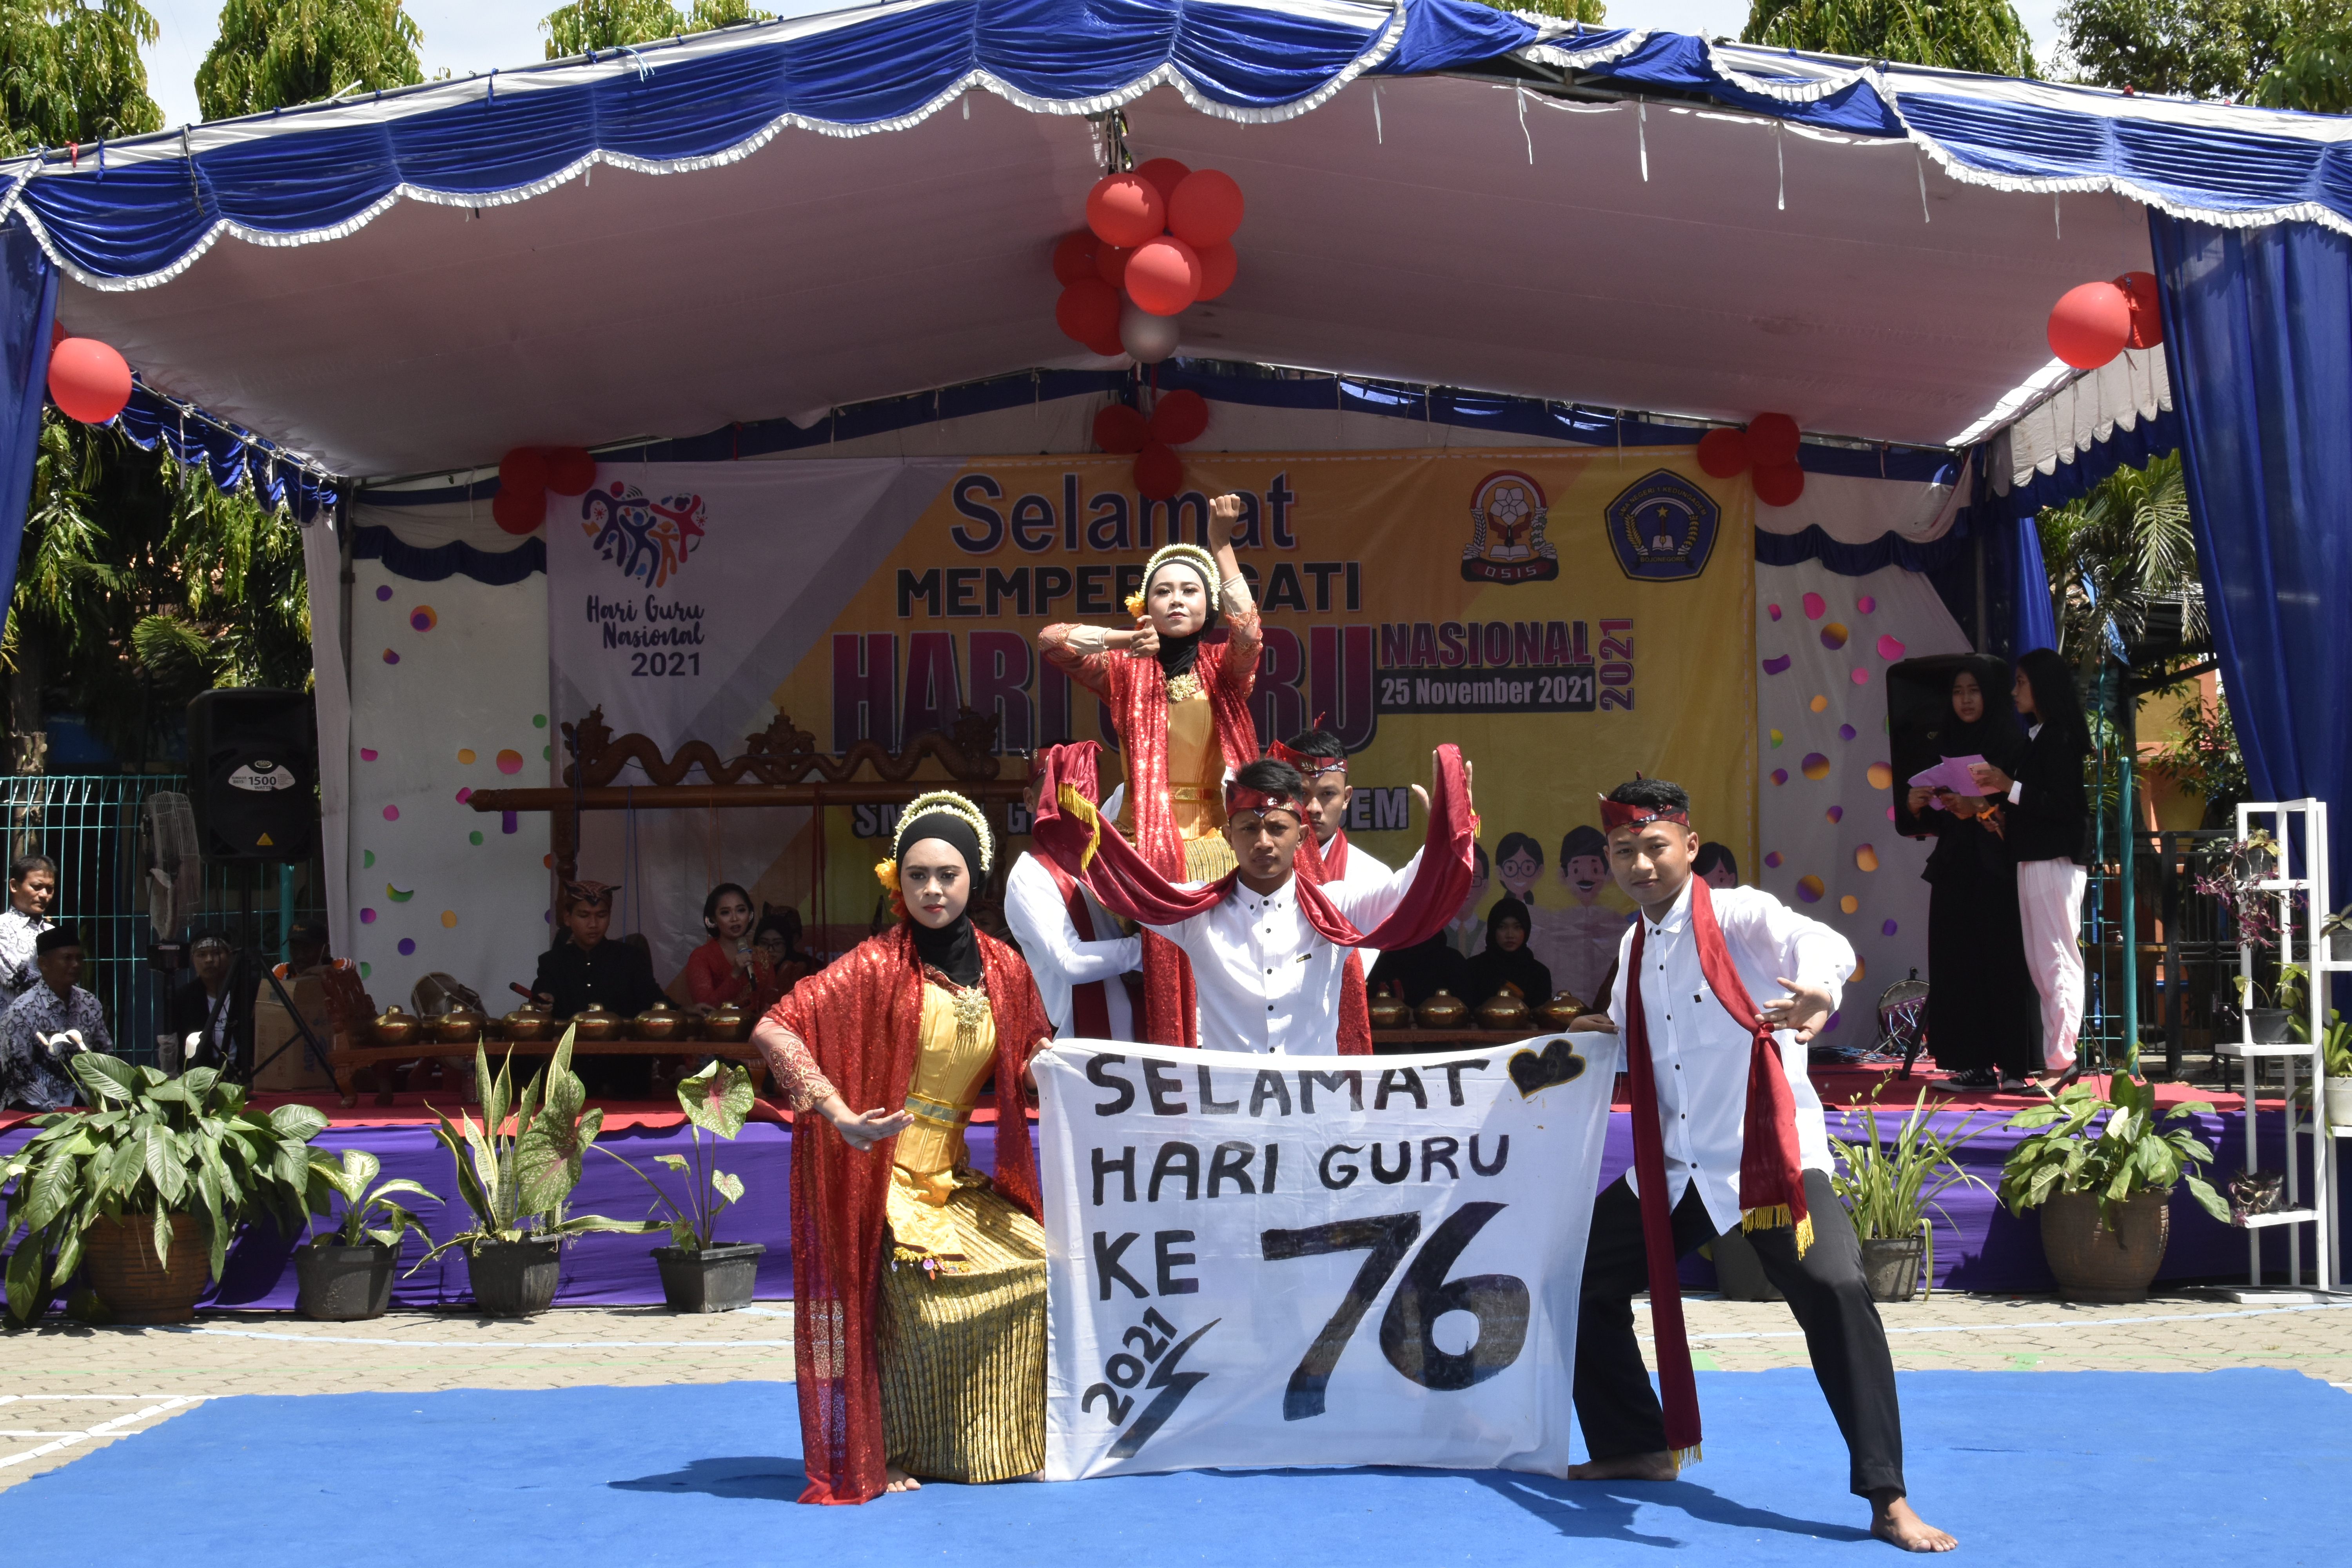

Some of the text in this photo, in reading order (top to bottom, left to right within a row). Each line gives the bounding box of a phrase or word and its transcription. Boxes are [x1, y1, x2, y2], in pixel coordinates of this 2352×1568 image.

[950, 470, 1296, 554] Selamat
[1618, 503, 1630, 517] SMA
[1629, 488, 1655, 503] NEGERI
[1663, 487, 1708, 515] KEDUNGADEM
[897, 561, 1361, 618] MEMPERATI
[1485, 564, 1537, 578] OSIS
[587, 594, 704, 623] Hari Guru
[603, 621, 705, 649] Nasional
[1381, 620, 1594, 668] NASIONAL
[631, 652, 700, 677] 2021
[1599, 619, 1634, 711] 2021
[1381, 675, 1593, 705] 25 November 2021
[249, 777, 276, 785] 1500
[1085, 1053, 1491, 1117] SELAMAT
[1091, 1134, 1510, 1206] HARI GURU
[1093, 1201, 1531, 1421] KE 76
[1081, 1306, 1178, 1426] 2021
